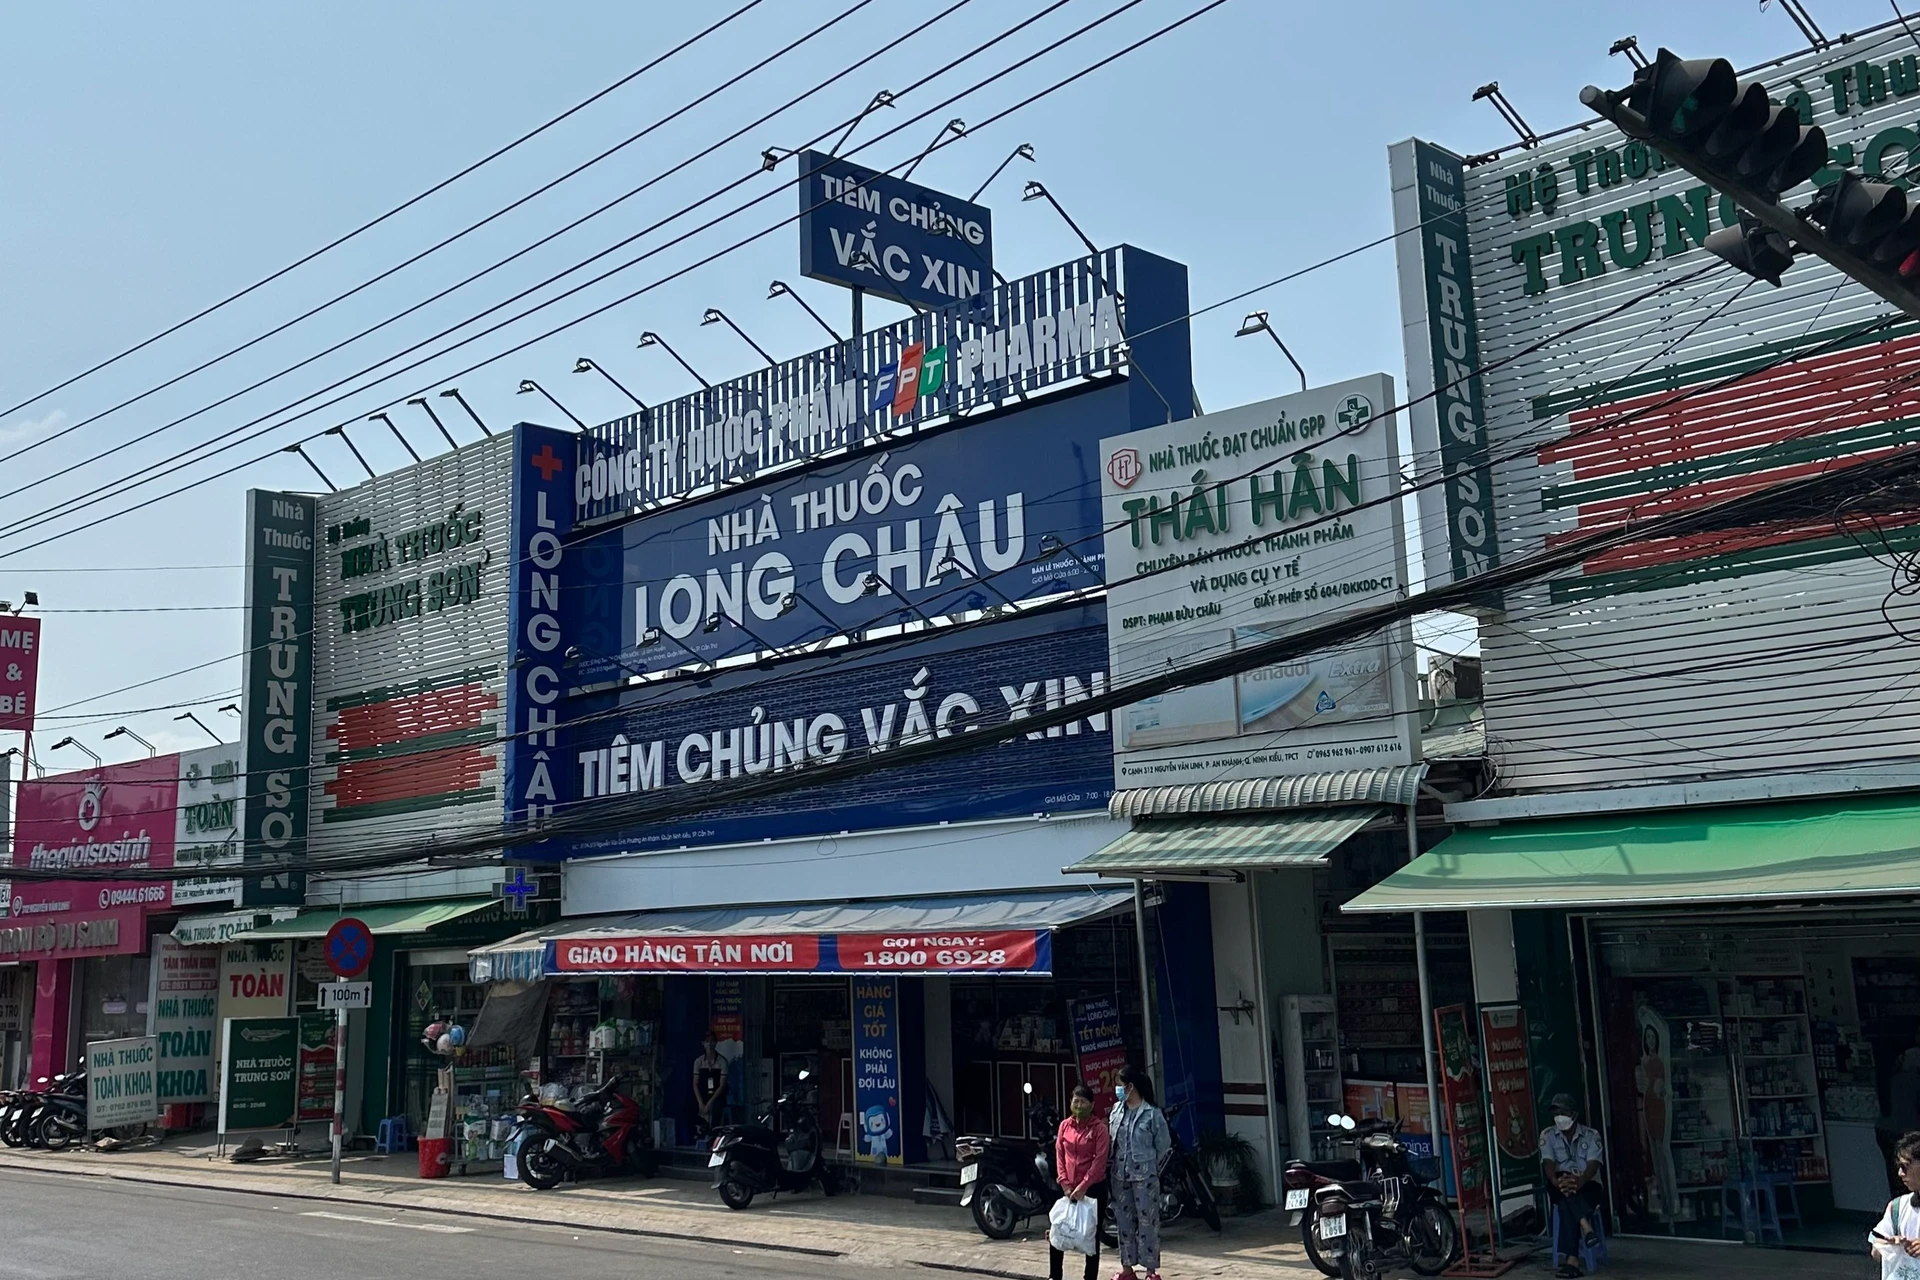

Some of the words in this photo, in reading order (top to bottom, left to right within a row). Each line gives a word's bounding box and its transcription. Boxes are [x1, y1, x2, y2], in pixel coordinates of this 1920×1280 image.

[1430, 161, 1455, 187] Nhà
[1426, 182, 1464, 214] Thuốc
[1505, 161, 1558, 216] Hệ
[821, 173, 881, 214] TIÊM
[889, 201, 985, 246] CHỦNG
[829, 220, 911, 282] VẮC
[921, 254, 981, 300] XIN
[1434, 230, 1477, 445] TRUNG
[575, 450, 641, 506] CÔNG
[650, 435, 683, 484] TY
[688, 407, 763, 472] DƯỢC
[771, 372, 857, 448] PHẨM
[873, 353, 943, 403] FPT
[961, 294, 1122, 390] PHARMA
[1149, 445, 1176, 473] NHÀ
[1179, 431, 1220, 466] THUỐC
[1222, 432, 1247, 458] ĐẠT
[1250, 410, 1296, 450] CHUẨN
[1299, 414, 1326, 441] GPP
[272, 499, 305, 521] Nhà
[708, 494, 782, 556] NHÀ
[791, 452, 924, 533] THUỐC
[1121, 468, 1230, 549] THÁI
[1456, 460, 1491, 579] SƠN
[263, 525, 312, 552] Thuốc
[341, 532, 391, 580] NHÀ
[395, 503, 481, 564] THUỐC
[1136, 553, 1185, 576] CHUYÊN
[1187, 547, 1214, 567] BÁN
[1217, 535, 1261, 562] THUỐC
[1263, 528, 1310, 554] THÀNH
[1313, 517, 1355, 544] PHẨM
[526, 491, 563, 653] LONG
[635, 552, 797, 648] LONG
[821, 492, 1027, 604] CHÂU
[1190, 572, 1208, 594] VÀ
[1210, 570, 1248, 593] DỤNG
[1250, 566, 1269, 586] CỤ
[1272, 566, 1282, 581] Y
[1284, 556, 1301, 578] TẾ
[339, 579, 421, 634] TRUNG
[1253, 589, 1278, 609] GIẤY
[1278, 588, 1303, 606] PHÉP
[1304, 581, 1318, 601] SỐ
[1122, 616, 1147, 629] DSPT:
[1147, 612, 1174, 626] PHẠM
[1175, 604, 1195, 620] BỬU
[1195, 602, 1222, 619] CHÂU
[0, 629, 34, 656] MẸ
[6, 662, 23, 682] &
[263, 567, 298, 755] TRUNG
[1328, 657, 1382, 679] Extra
[0, 691, 27, 715] BÉ
[578, 732, 665, 798] TIÊM
[676, 706, 848, 785] CHỦNG
[861, 666, 981, 754] VẮC
[1000, 671, 1111, 744] XIN
[524, 666, 561, 843] CHÂU
[1127, 767, 1143, 776] CẠNH
[1144, 765, 1154, 774] 312
[1154, 761, 1177, 773] NGUYỄN
[1177, 761, 1190, 771] VĂN
[1205, 760, 1212, 768] P.
[1212, 760, 1221, 768] AN
[1252, 754, 1268, 764] NINH
[1284, 752, 1299, 761] TPCT
[1315, 749, 1331, 759] 0965
[1331, 748, 1343, 757] 962
[1376, 743, 1389, 753] 612
[1390, 742, 1402, 752] 616
[184, 793, 238, 835] TOÀN
[260, 771, 294, 890] SƠN
[30, 829, 152, 869] thegioisosinh
[34, 918, 56, 956] BỘ
[193, 921, 217, 939] THUỐC
[882, 936, 921, 949] GỌI
[923, 936, 985, 947] NGAY:
[227, 946, 248, 963] NHÀ
[567, 945, 618, 965] GIAO
[625, 940, 687, 964] HÀNG
[693, 939, 742, 968] TẬN
[750, 941, 794, 963] NƠI
[863, 949, 927, 966] 1800
[936, 949, 1006, 965] 6928
[229, 967, 284, 998] TOÀN
[1826, 968, 1833, 979] 2
[158, 995, 179, 1018] NHÀ
[182, 991, 215, 1017] THUỐC
[332, 989, 361, 1001] 100m
[856, 982, 892, 999] HÀNG
[864, 1001, 886, 1018] GIÁ
[1087, 1010, 1103, 1021] LONG
[1102, 1006, 1117, 1018] CHÂU
[158, 1026, 212, 1058] TOÀN
[863, 1020, 887, 1037] TỐT
[1078, 1023, 1094, 1040] TẾT
[94, 1048, 115, 1068] NHÀ
[118, 1041, 153, 1065] THUỐC
[236, 1057, 257, 1069] NHÀ
[258, 1054, 292, 1068] THUỐC
[860, 1045, 893, 1059] KHÔNG
[234, 1071, 269, 1083] TRUNG
[865, 1060, 888, 1074] PHẢI
[94, 1069, 121, 1101] TOÀN
[124, 1070, 152, 1097] KHOA
[157, 1069, 208, 1097] KHOA
[858, 1077, 876, 1091] ĐỢI
[877, 1075, 896, 1089] LÂU
